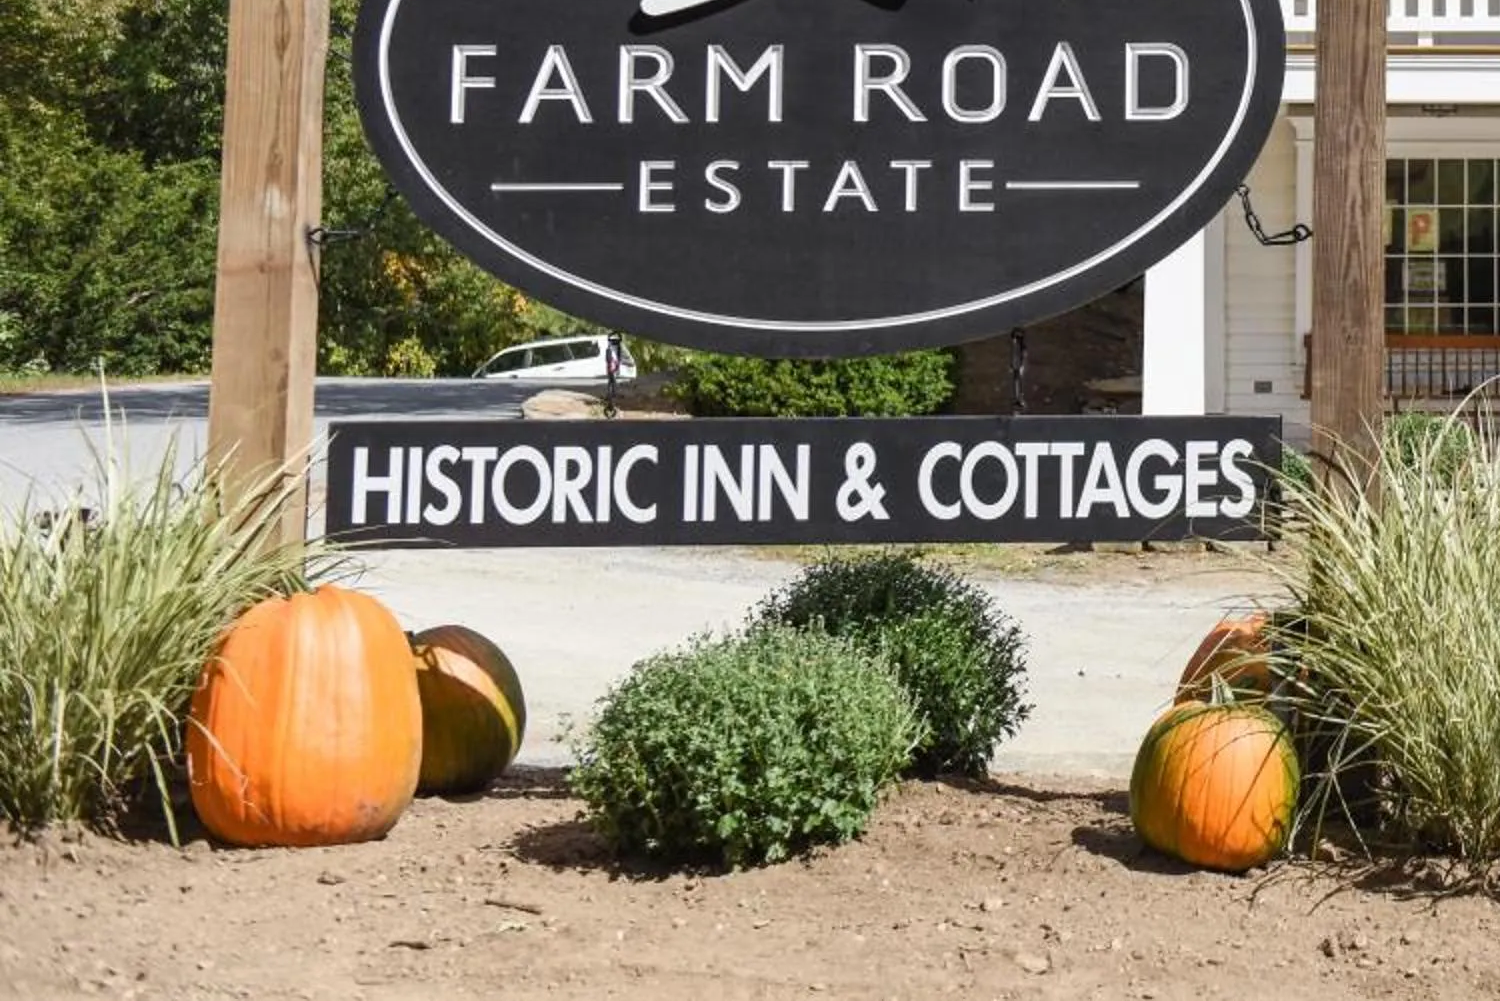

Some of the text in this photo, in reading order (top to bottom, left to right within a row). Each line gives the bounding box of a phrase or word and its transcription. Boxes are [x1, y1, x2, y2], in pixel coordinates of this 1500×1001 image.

[449, 40, 1191, 125] FARM ROAD
[637, 158, 996, 215] ESTATE
[350, 438, 1256, 526] HISTORIC INN & COTTAGES
